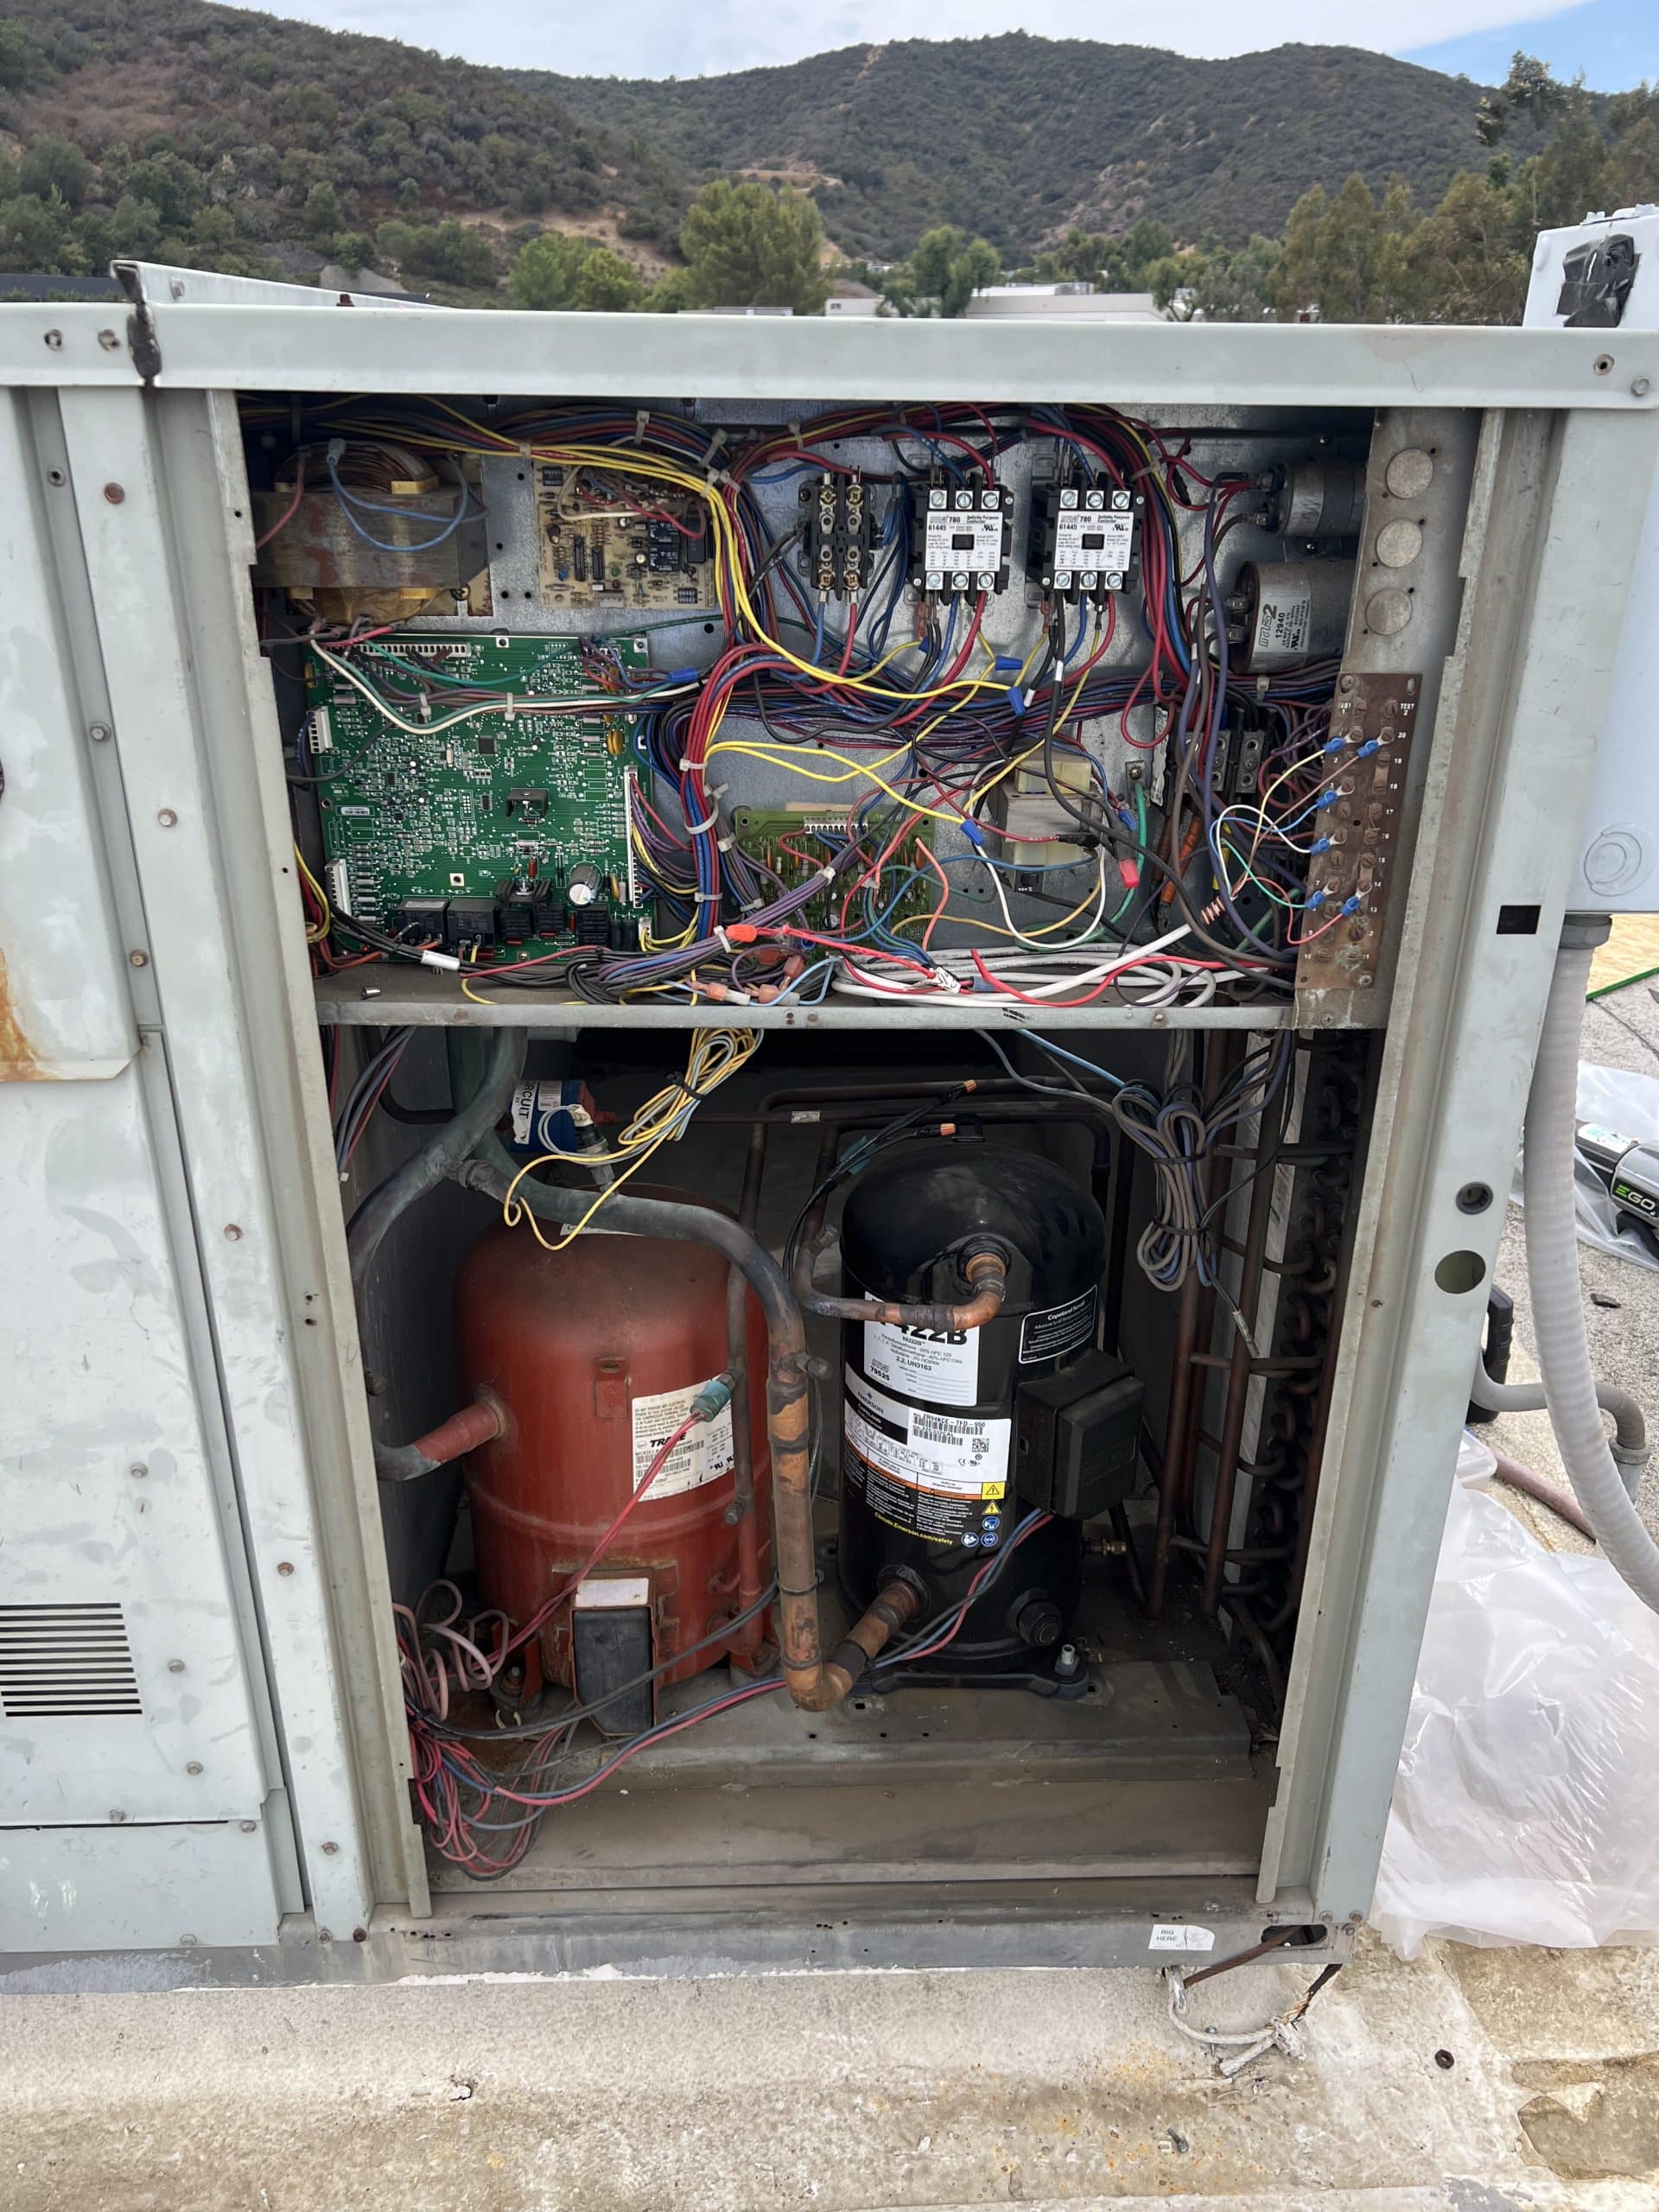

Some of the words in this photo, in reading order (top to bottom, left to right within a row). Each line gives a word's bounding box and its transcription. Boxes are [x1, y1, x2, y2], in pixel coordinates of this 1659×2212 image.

[1275, 613, 1286, 638] 12940
[1615, 1184, 1656, 1211] EGO
[650, 1432, 687, 1447] TRAE
